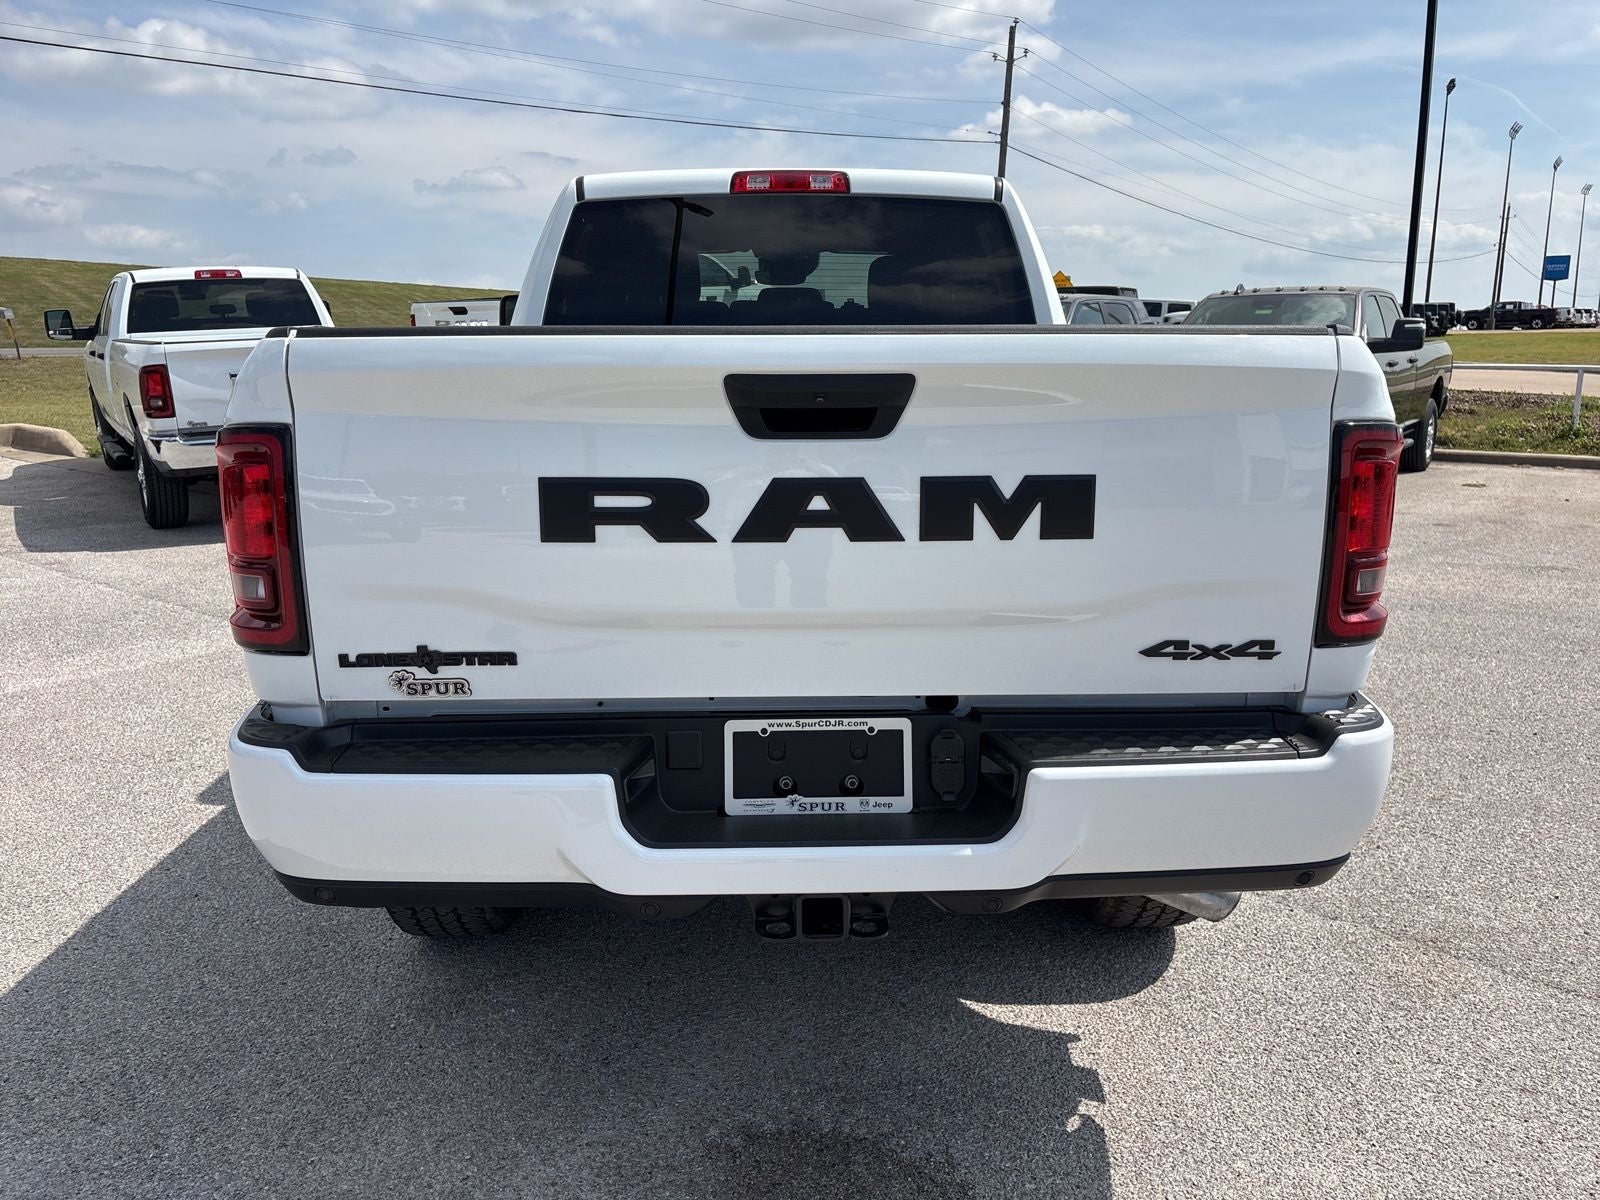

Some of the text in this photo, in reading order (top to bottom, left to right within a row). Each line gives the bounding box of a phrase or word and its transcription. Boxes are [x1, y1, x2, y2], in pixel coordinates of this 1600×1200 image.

[537, 474, 1097, 544] RAM
[1138, 639, 1282, 661] 4x4
[338, 651, 518, 668] LONE STAR
[406, 682, 469, 696] SPUR
[767, 720, 869, 729] www.SpurCDJR.com
[798, 801, 846, 812] SPUR
[872, 801, 893, 809] Jeep
